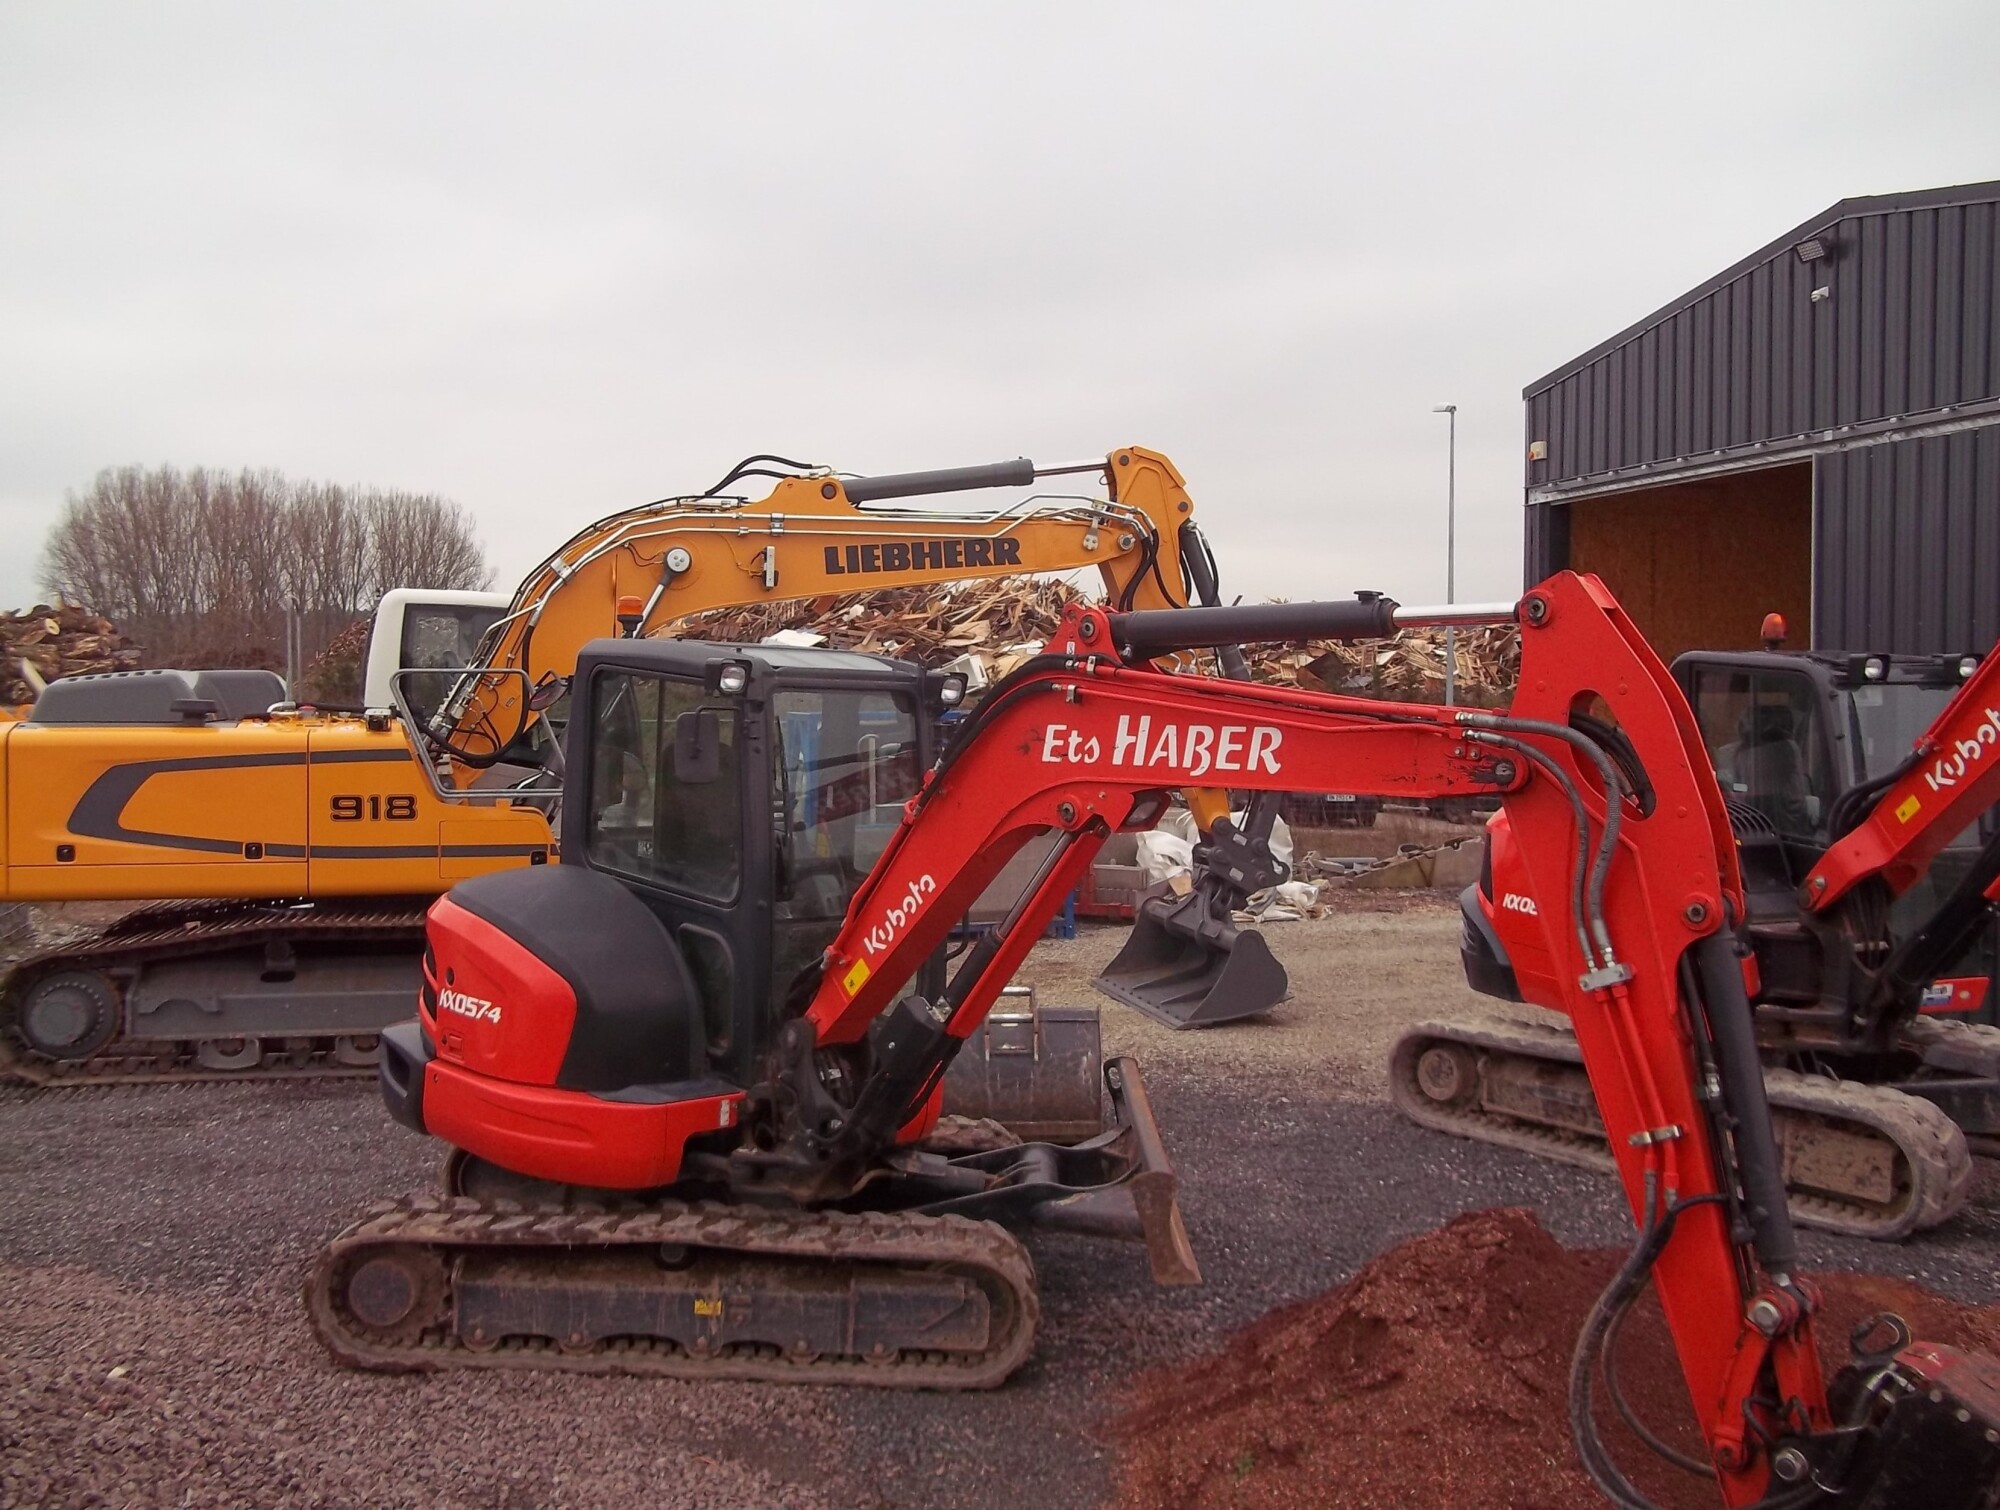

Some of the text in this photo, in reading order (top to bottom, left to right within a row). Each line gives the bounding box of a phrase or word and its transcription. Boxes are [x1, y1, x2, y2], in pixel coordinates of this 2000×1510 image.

[824, 537, 1022, 575] LIEBHERR
[1041, 715, 1283, 777] Ets HABER
[330, 794, 419, 822] 918
[863, 874, 937, 955] Kubota
